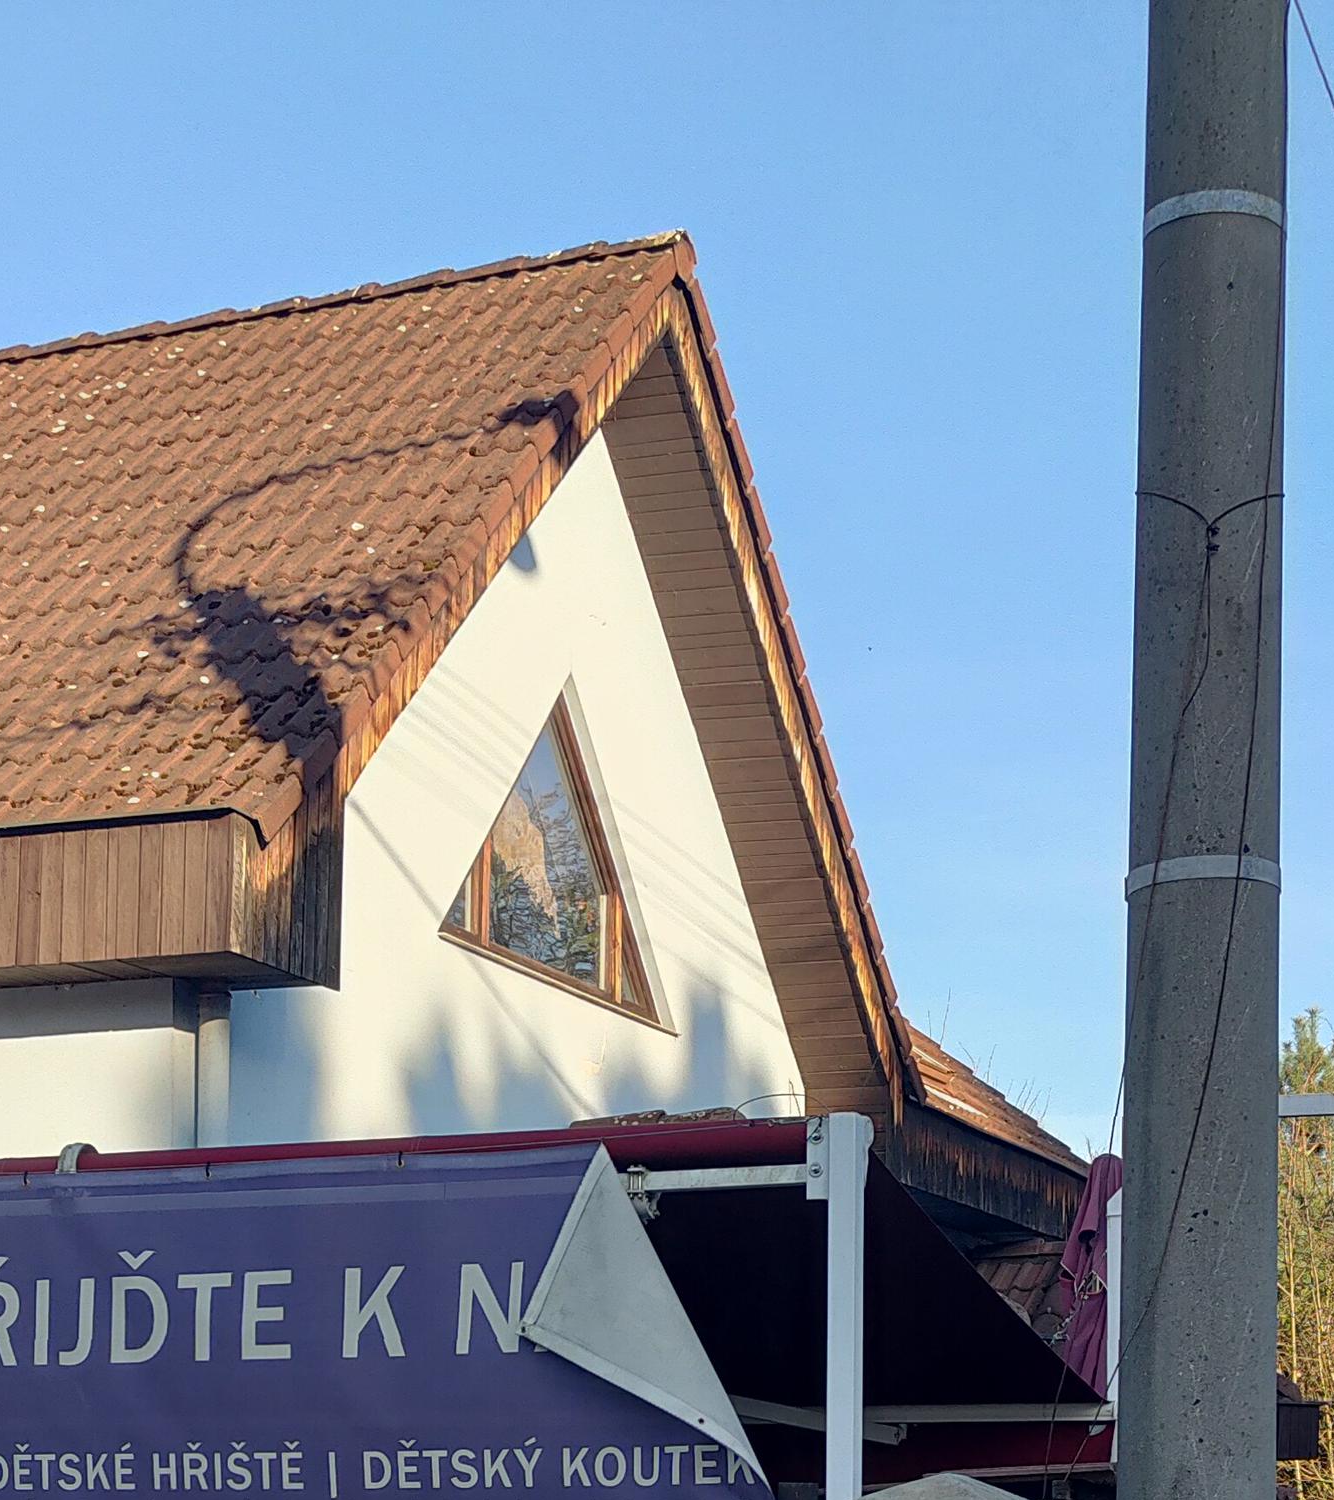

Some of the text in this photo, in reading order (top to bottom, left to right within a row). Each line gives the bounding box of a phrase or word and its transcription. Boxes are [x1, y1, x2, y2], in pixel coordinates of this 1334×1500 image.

[342, 1265, 406, 1358] K
[455, 1261, 548, 1355] N
[152, 1441, 304, 1491] HŘIŠTĚ
[363, 1437, 543, 1490] DĚTSKÝ
[563, 1444, 755, 1488] KOUTEK
